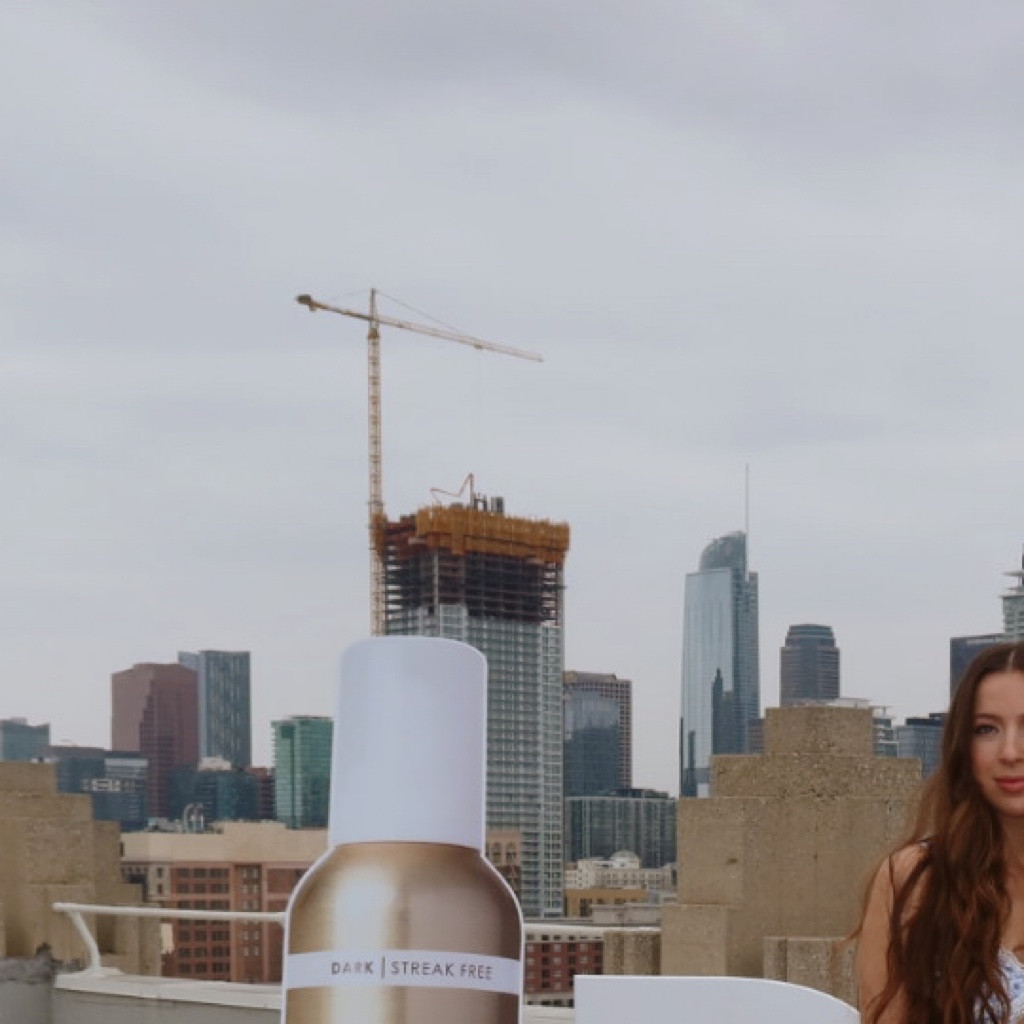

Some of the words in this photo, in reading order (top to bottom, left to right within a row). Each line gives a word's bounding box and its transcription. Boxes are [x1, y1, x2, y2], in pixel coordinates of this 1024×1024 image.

[331, 961, 375, 976] DARK
[391, 961, 455, 978] STREAK
[460, 964, 494, 980] FREE
